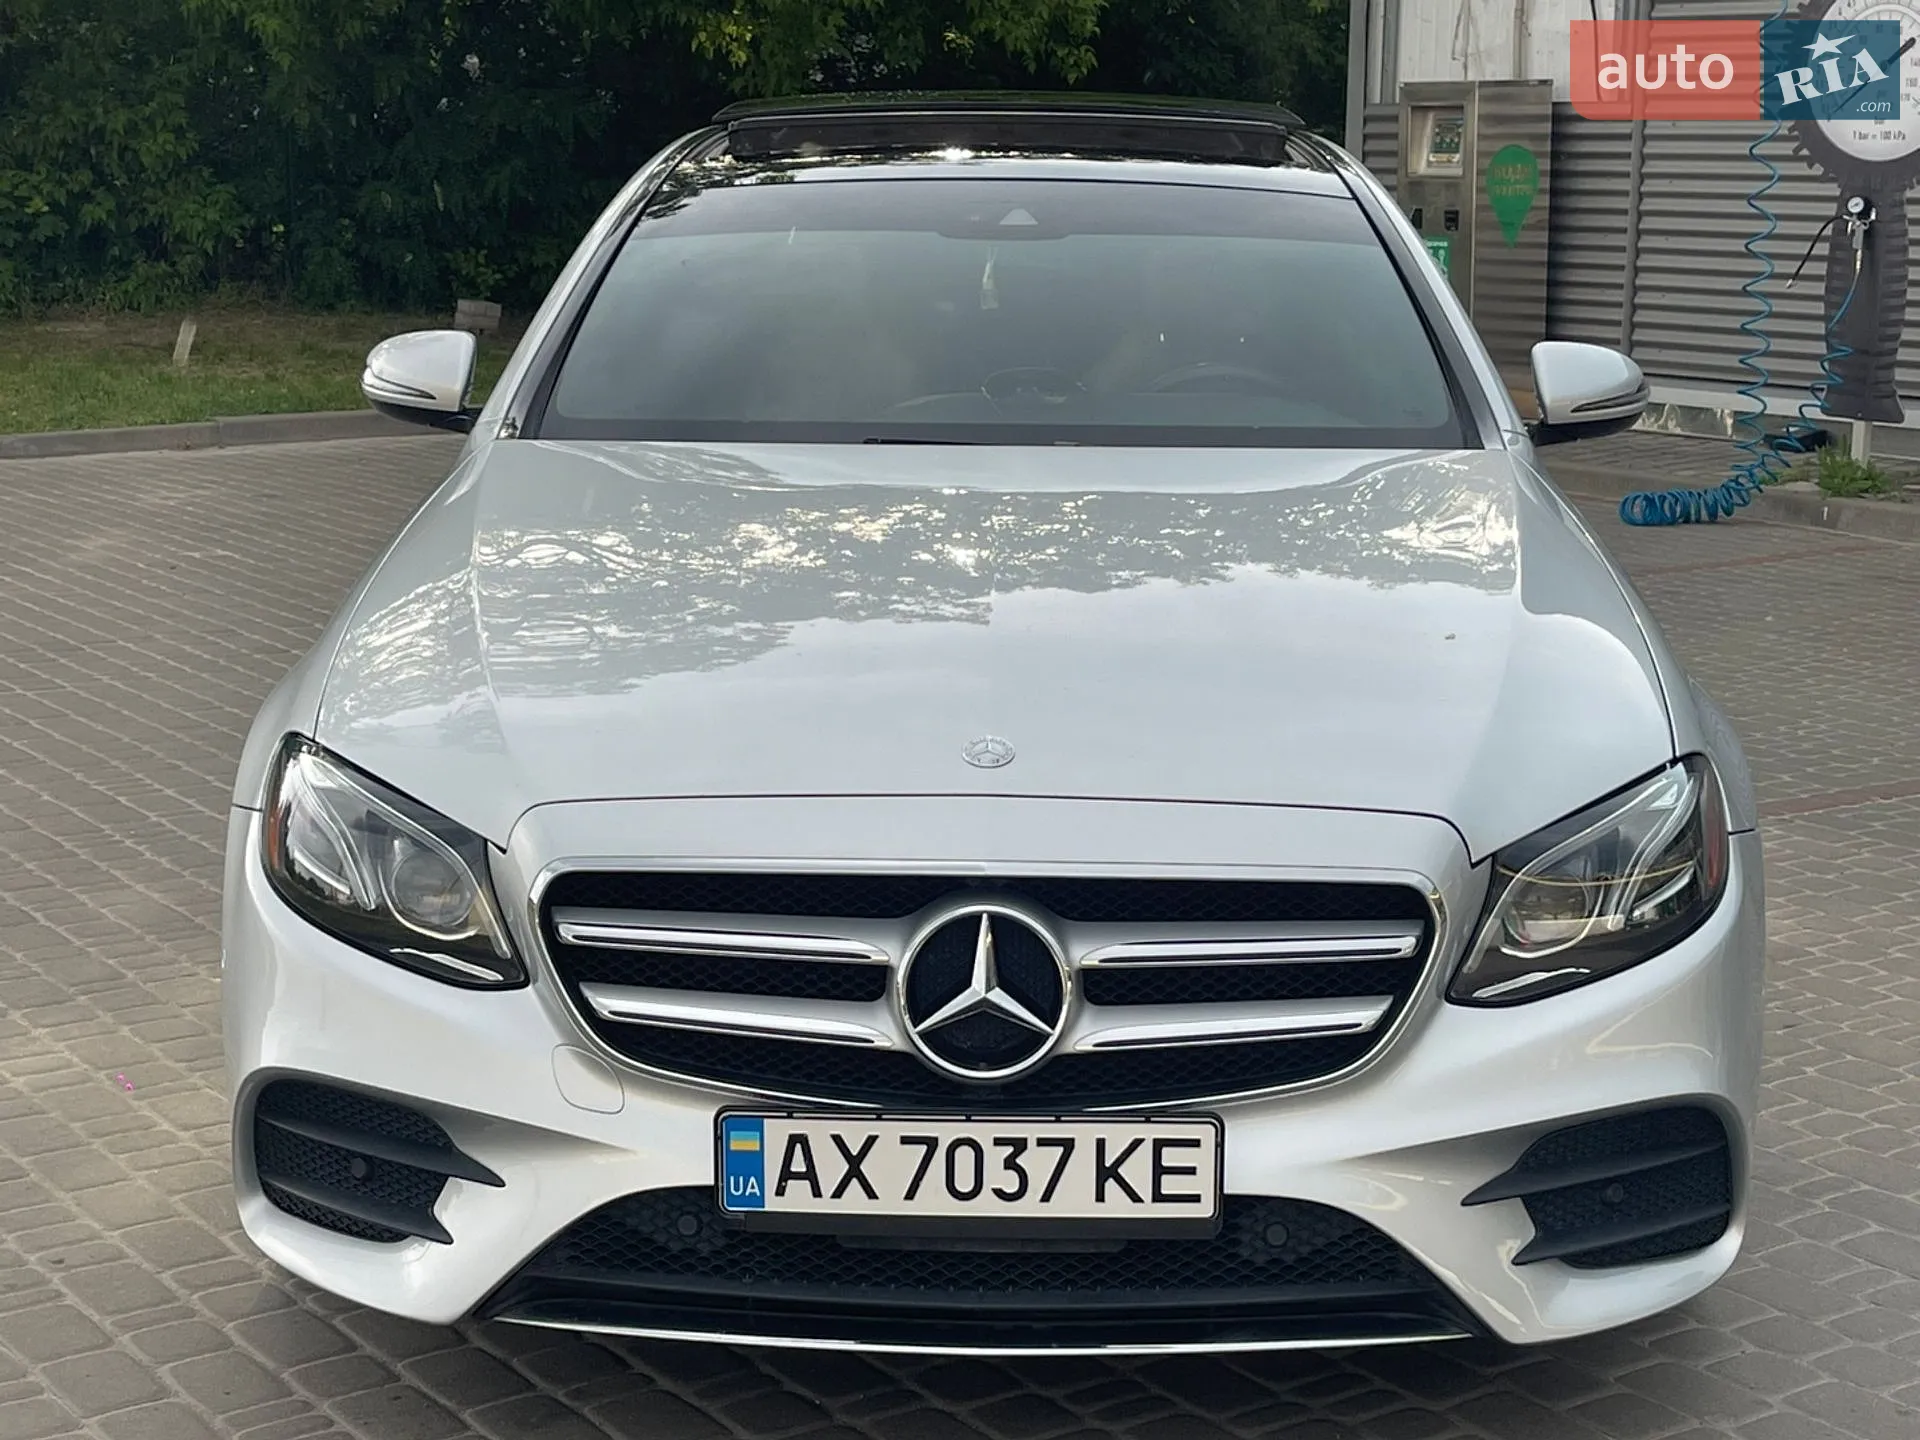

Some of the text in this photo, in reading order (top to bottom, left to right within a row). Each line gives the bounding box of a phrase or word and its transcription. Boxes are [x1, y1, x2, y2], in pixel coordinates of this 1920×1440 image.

[729, 1175, 761, 1196] UA
[775, 1133, 1202, 1204] AX 7037 KE
